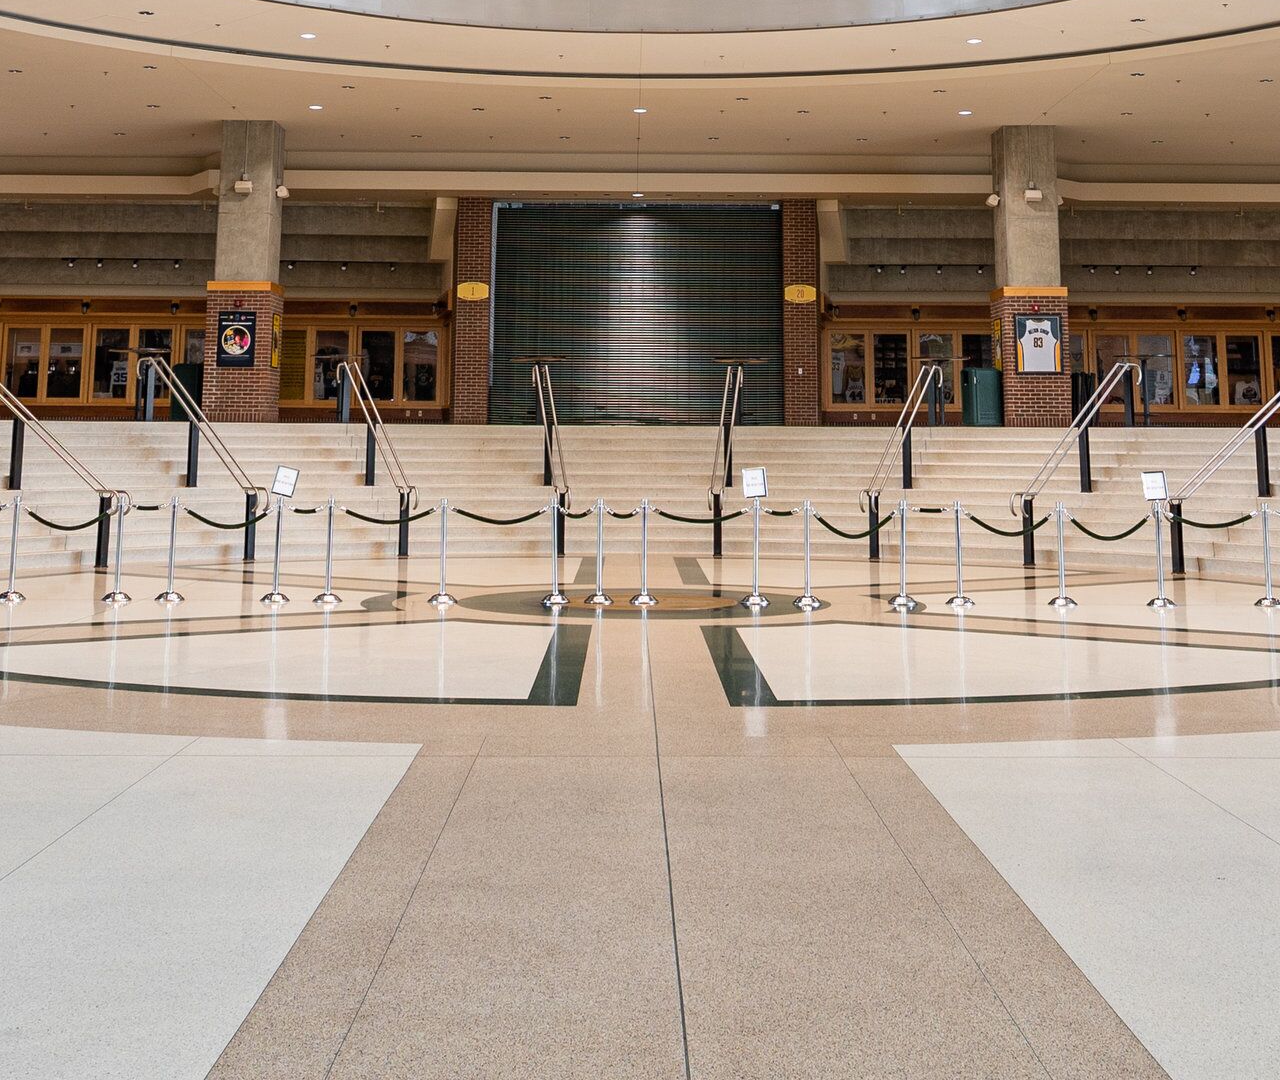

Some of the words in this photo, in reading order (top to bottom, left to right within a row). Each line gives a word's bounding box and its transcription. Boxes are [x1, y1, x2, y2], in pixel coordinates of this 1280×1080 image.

[796, 288, 805, 299] 20
[1033, 337, 1043, 348] 83
[113, 372, 127, 383] 35
[848, 390, 864, 401] 44
